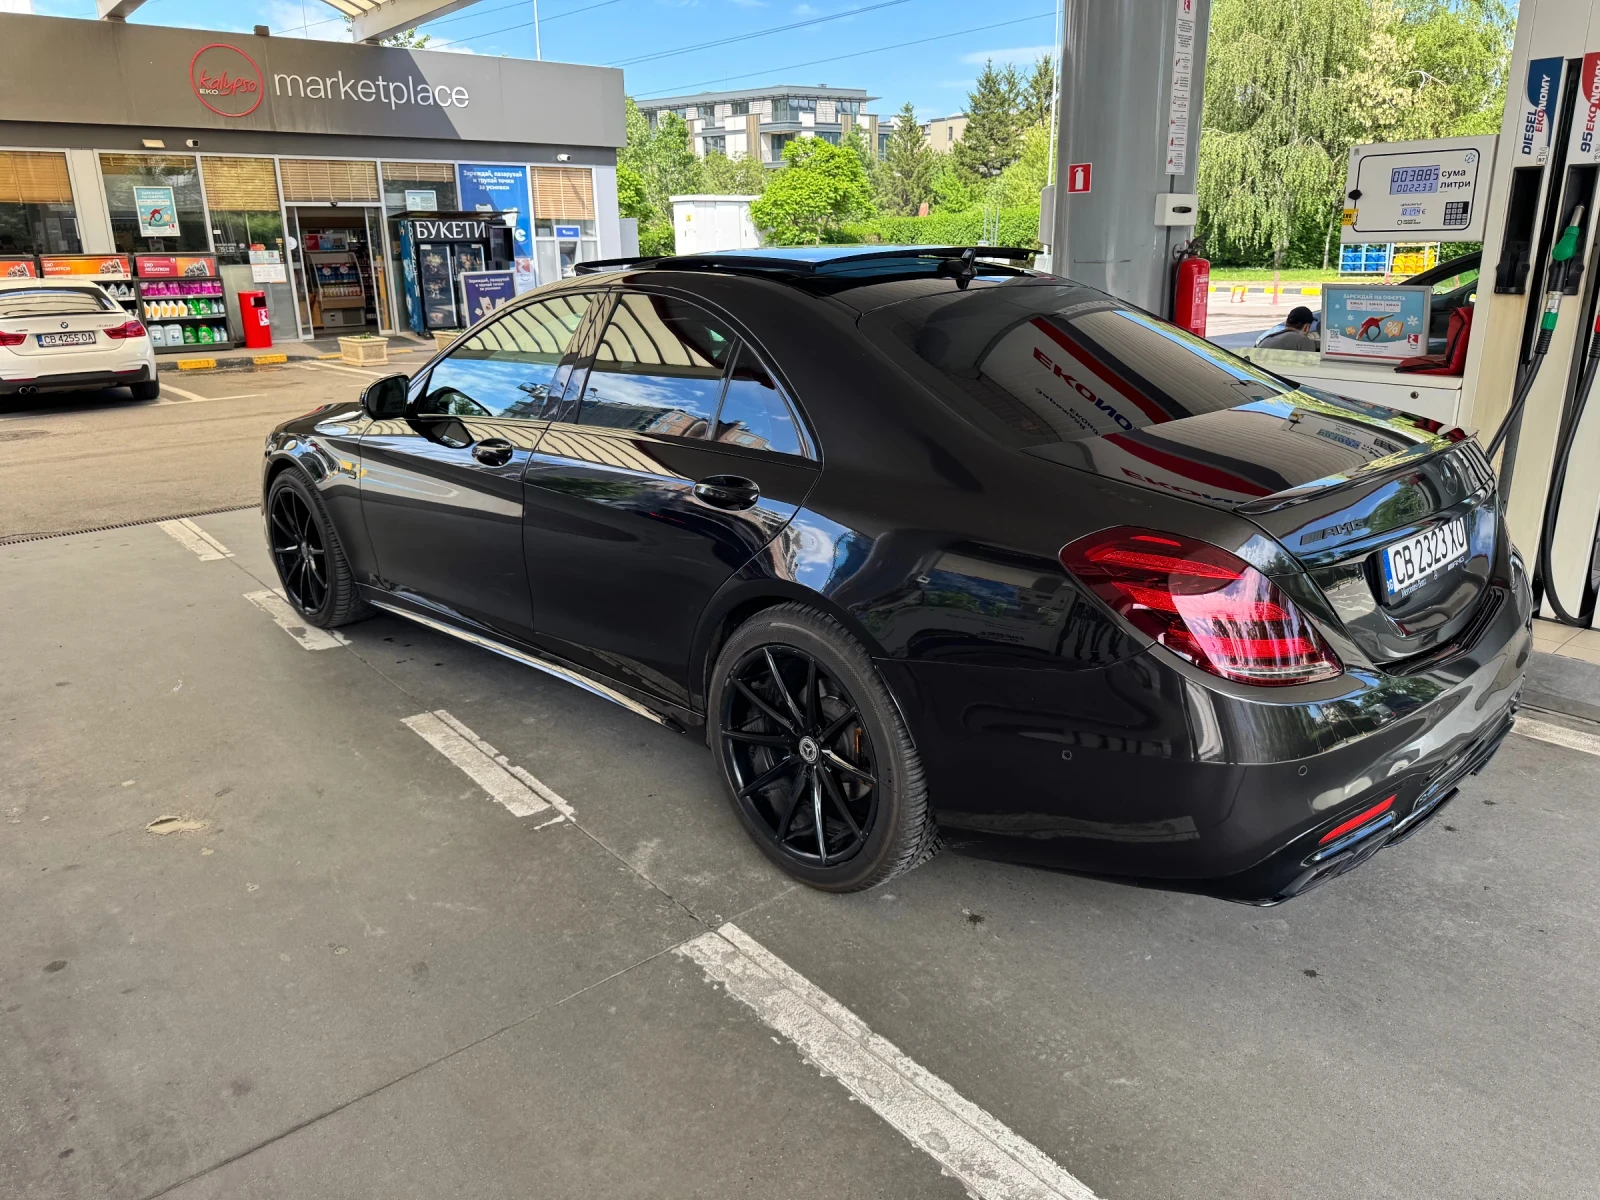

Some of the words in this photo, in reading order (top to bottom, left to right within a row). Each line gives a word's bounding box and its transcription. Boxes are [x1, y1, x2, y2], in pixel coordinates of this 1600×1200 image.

[274, 70, 469, 110] marketplace
[1534, 74, 1551, 132] EKONOMY
[1521, 109, 1538, 155] DIESEL
[1440, 180, 1471, 191] литри
[1441, 169, 1466, 178] сума
[414, 221, 487, 239] БУКЕТИ
[58, 334, 80, 343] 4255
[1414, 526, 1448, 574] 2323
